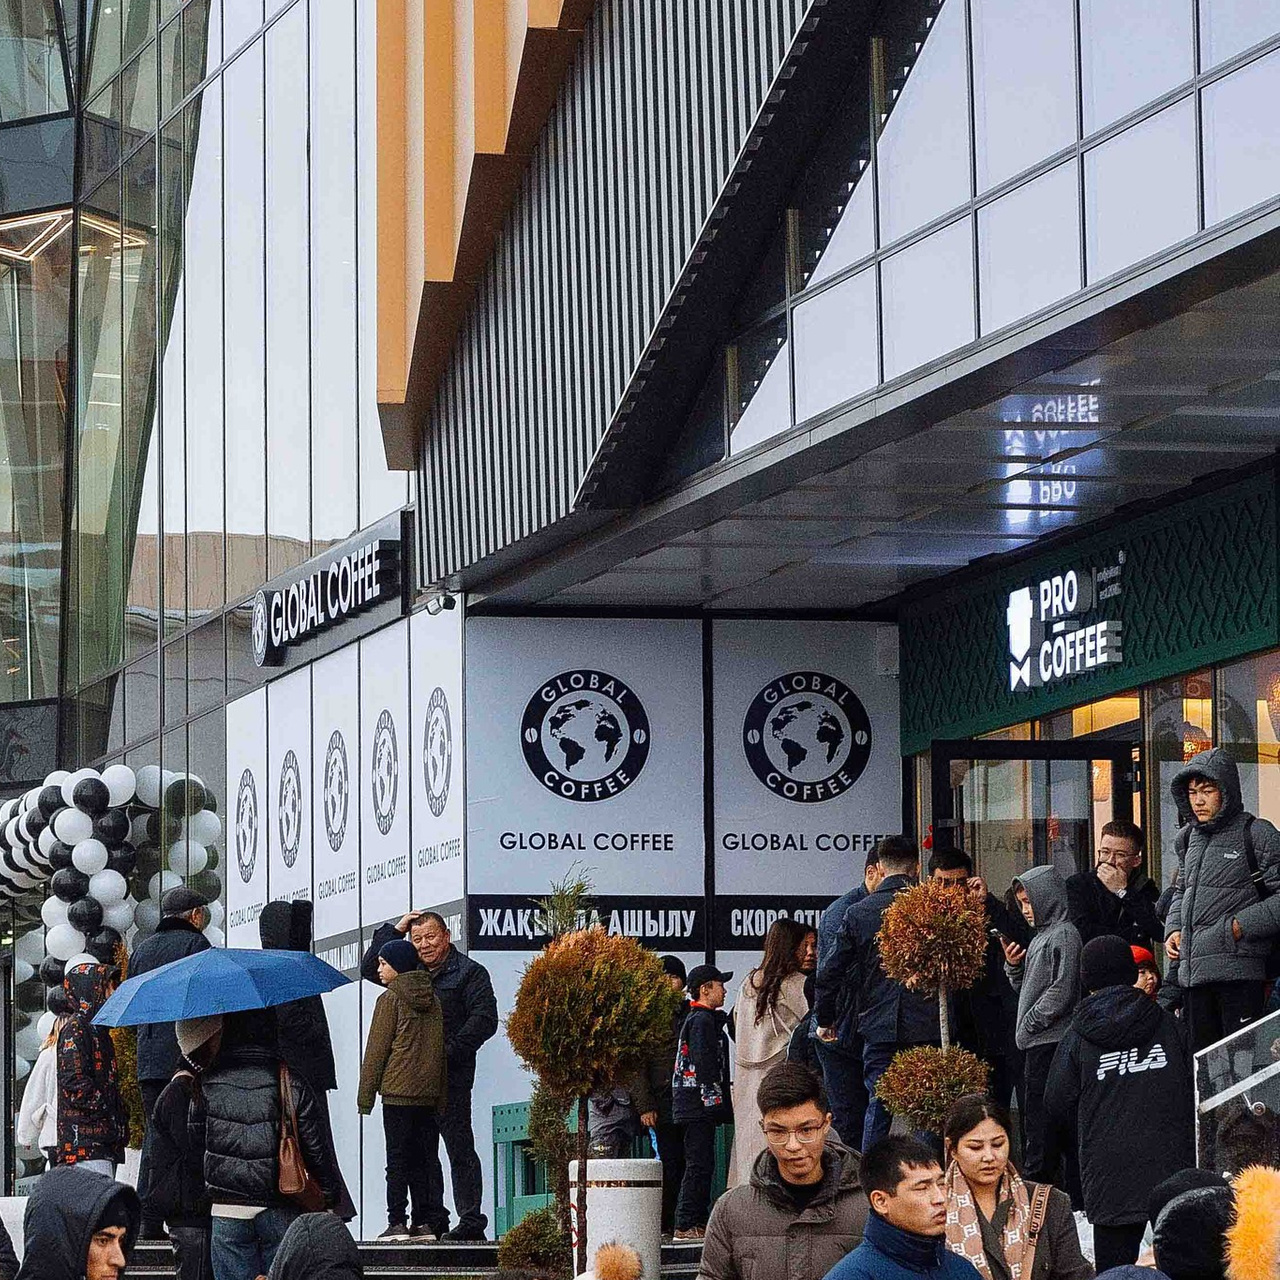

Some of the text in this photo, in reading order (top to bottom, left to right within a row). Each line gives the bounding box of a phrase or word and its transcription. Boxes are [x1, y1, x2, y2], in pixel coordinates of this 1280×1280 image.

[271, 571, 324, 647] GLOBAL
[327, 540, 380, 619] COFFEE
[1040, 570, 1078, 621] PRO
[1039, 621, 1108, 683] COFFEE
[541, 673, 629, 706] GLOBAL
[763, 675, 850, 706] GLOBAL
[543, 770, 631, 799] COFFEE
[765, 770, 853, 800] COFFEE
[499, 831, 674, 851] GLOBAL COFFEE
[722, 833, 893, 852] GLOBAL COFF
[479, 909, 600, 939] ЖАҚЫДА
[608, 910, 696, 937] АШЫЛУ
[1096, 1043, 1169, 1080] FILA
